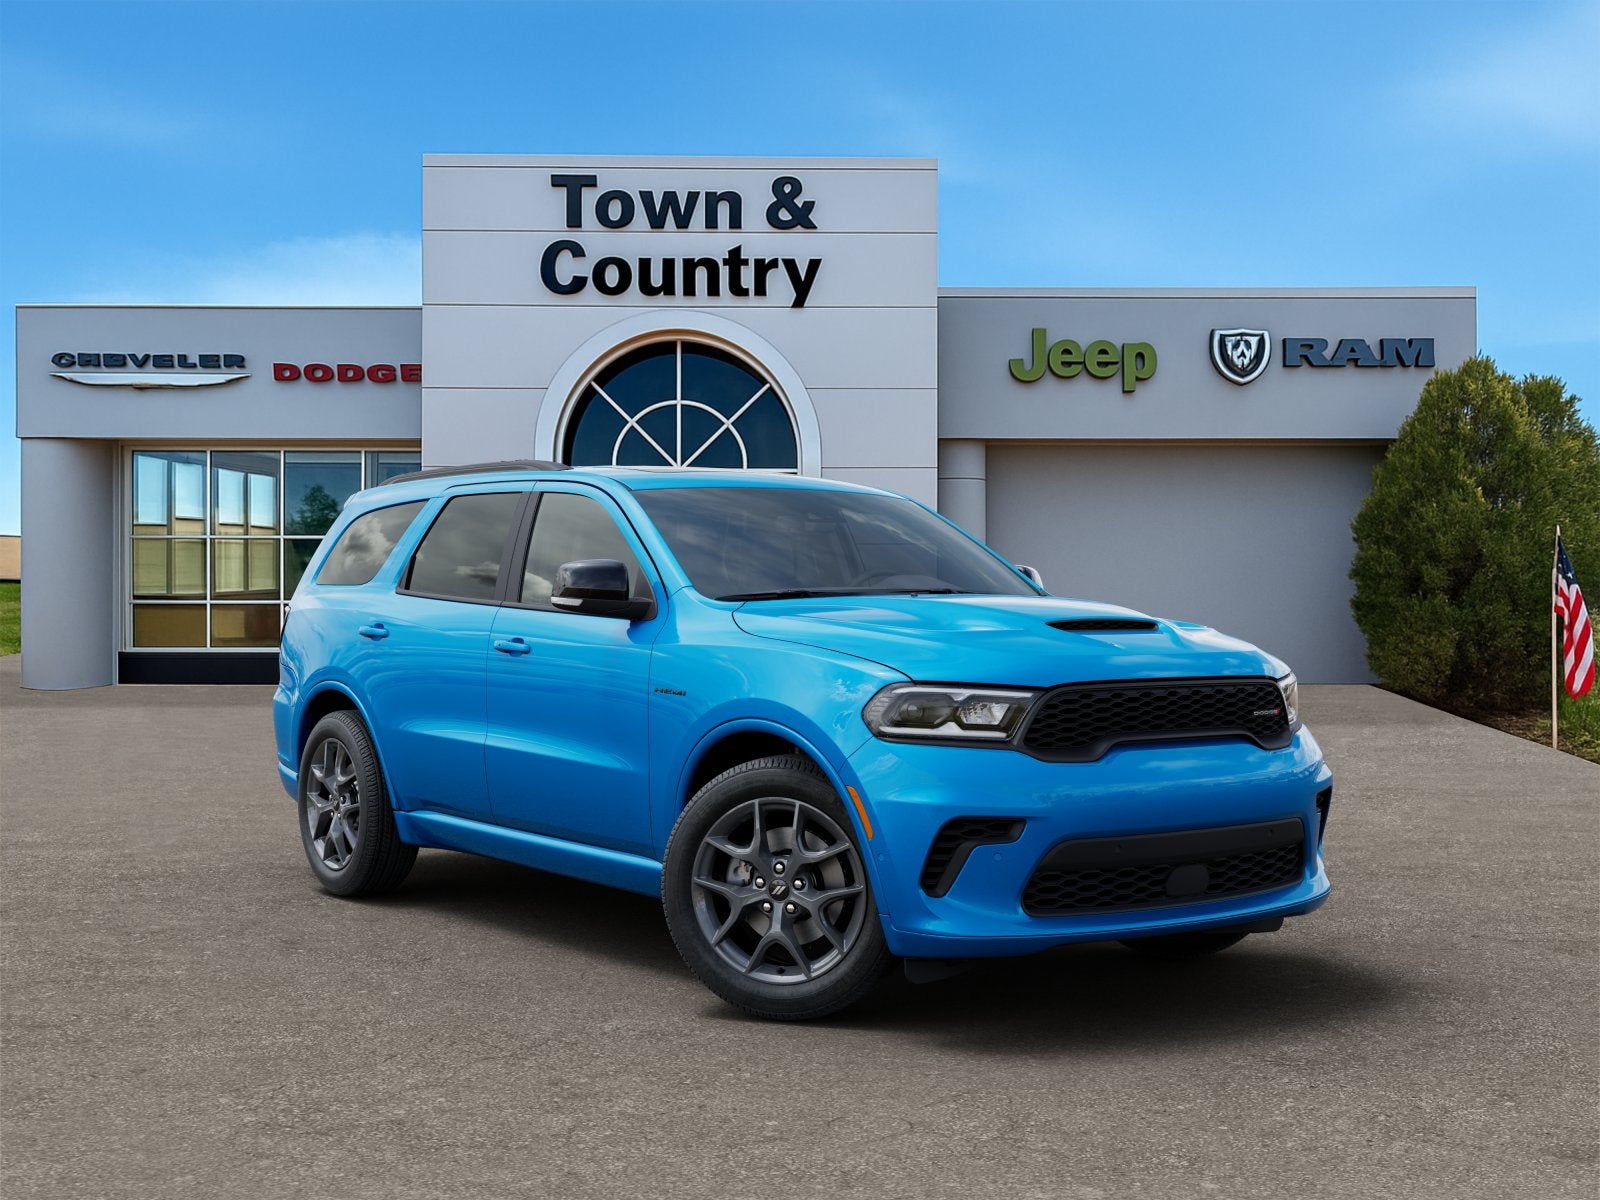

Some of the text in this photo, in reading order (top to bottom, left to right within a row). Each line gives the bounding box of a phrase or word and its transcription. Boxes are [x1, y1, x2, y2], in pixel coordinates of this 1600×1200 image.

[550, 173, 818, 230] Town &
[539, 238, 823, 308] Country
[273, 362, 422, 383] DODGE
[1009, 328, 1157, 392] Jeep
[1282, 337, 1435, 368] RAM
